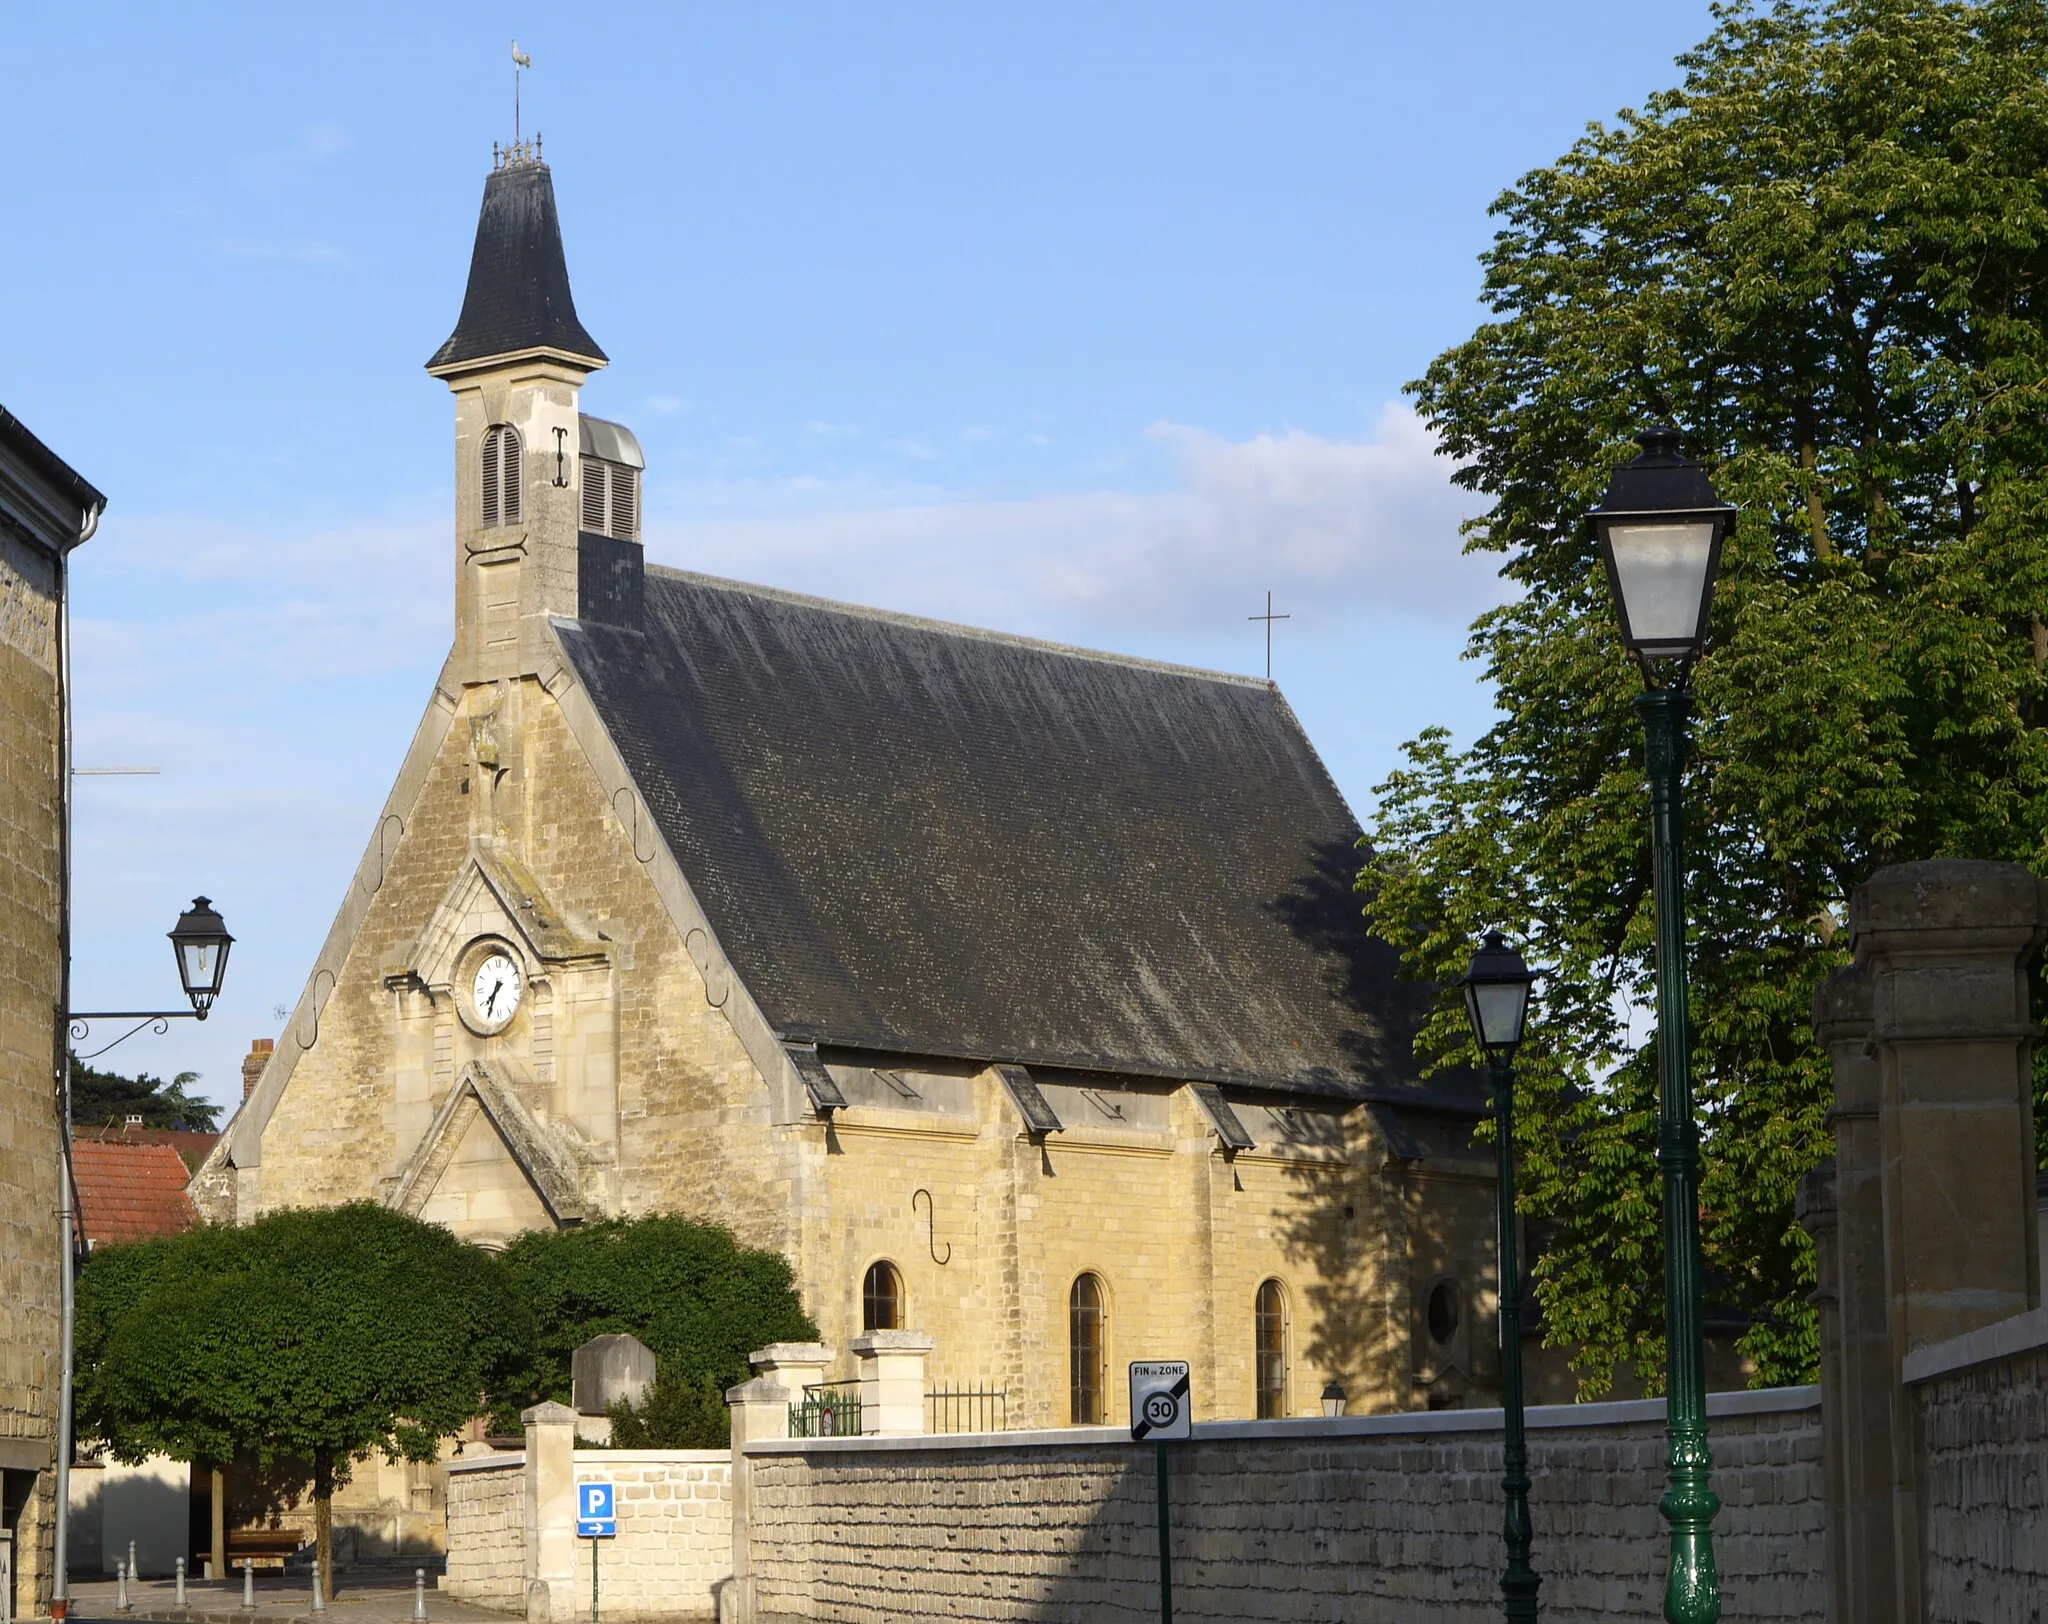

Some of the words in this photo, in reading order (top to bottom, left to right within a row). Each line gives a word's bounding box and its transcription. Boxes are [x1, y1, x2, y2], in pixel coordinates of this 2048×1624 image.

[1134, 1366, 1149, 1376] FIN
[1159, 1365, 1184, 1375] ZONE
[1150, 1402, 1172, 1418] 30
[588, 1489, 606, 1514] P
